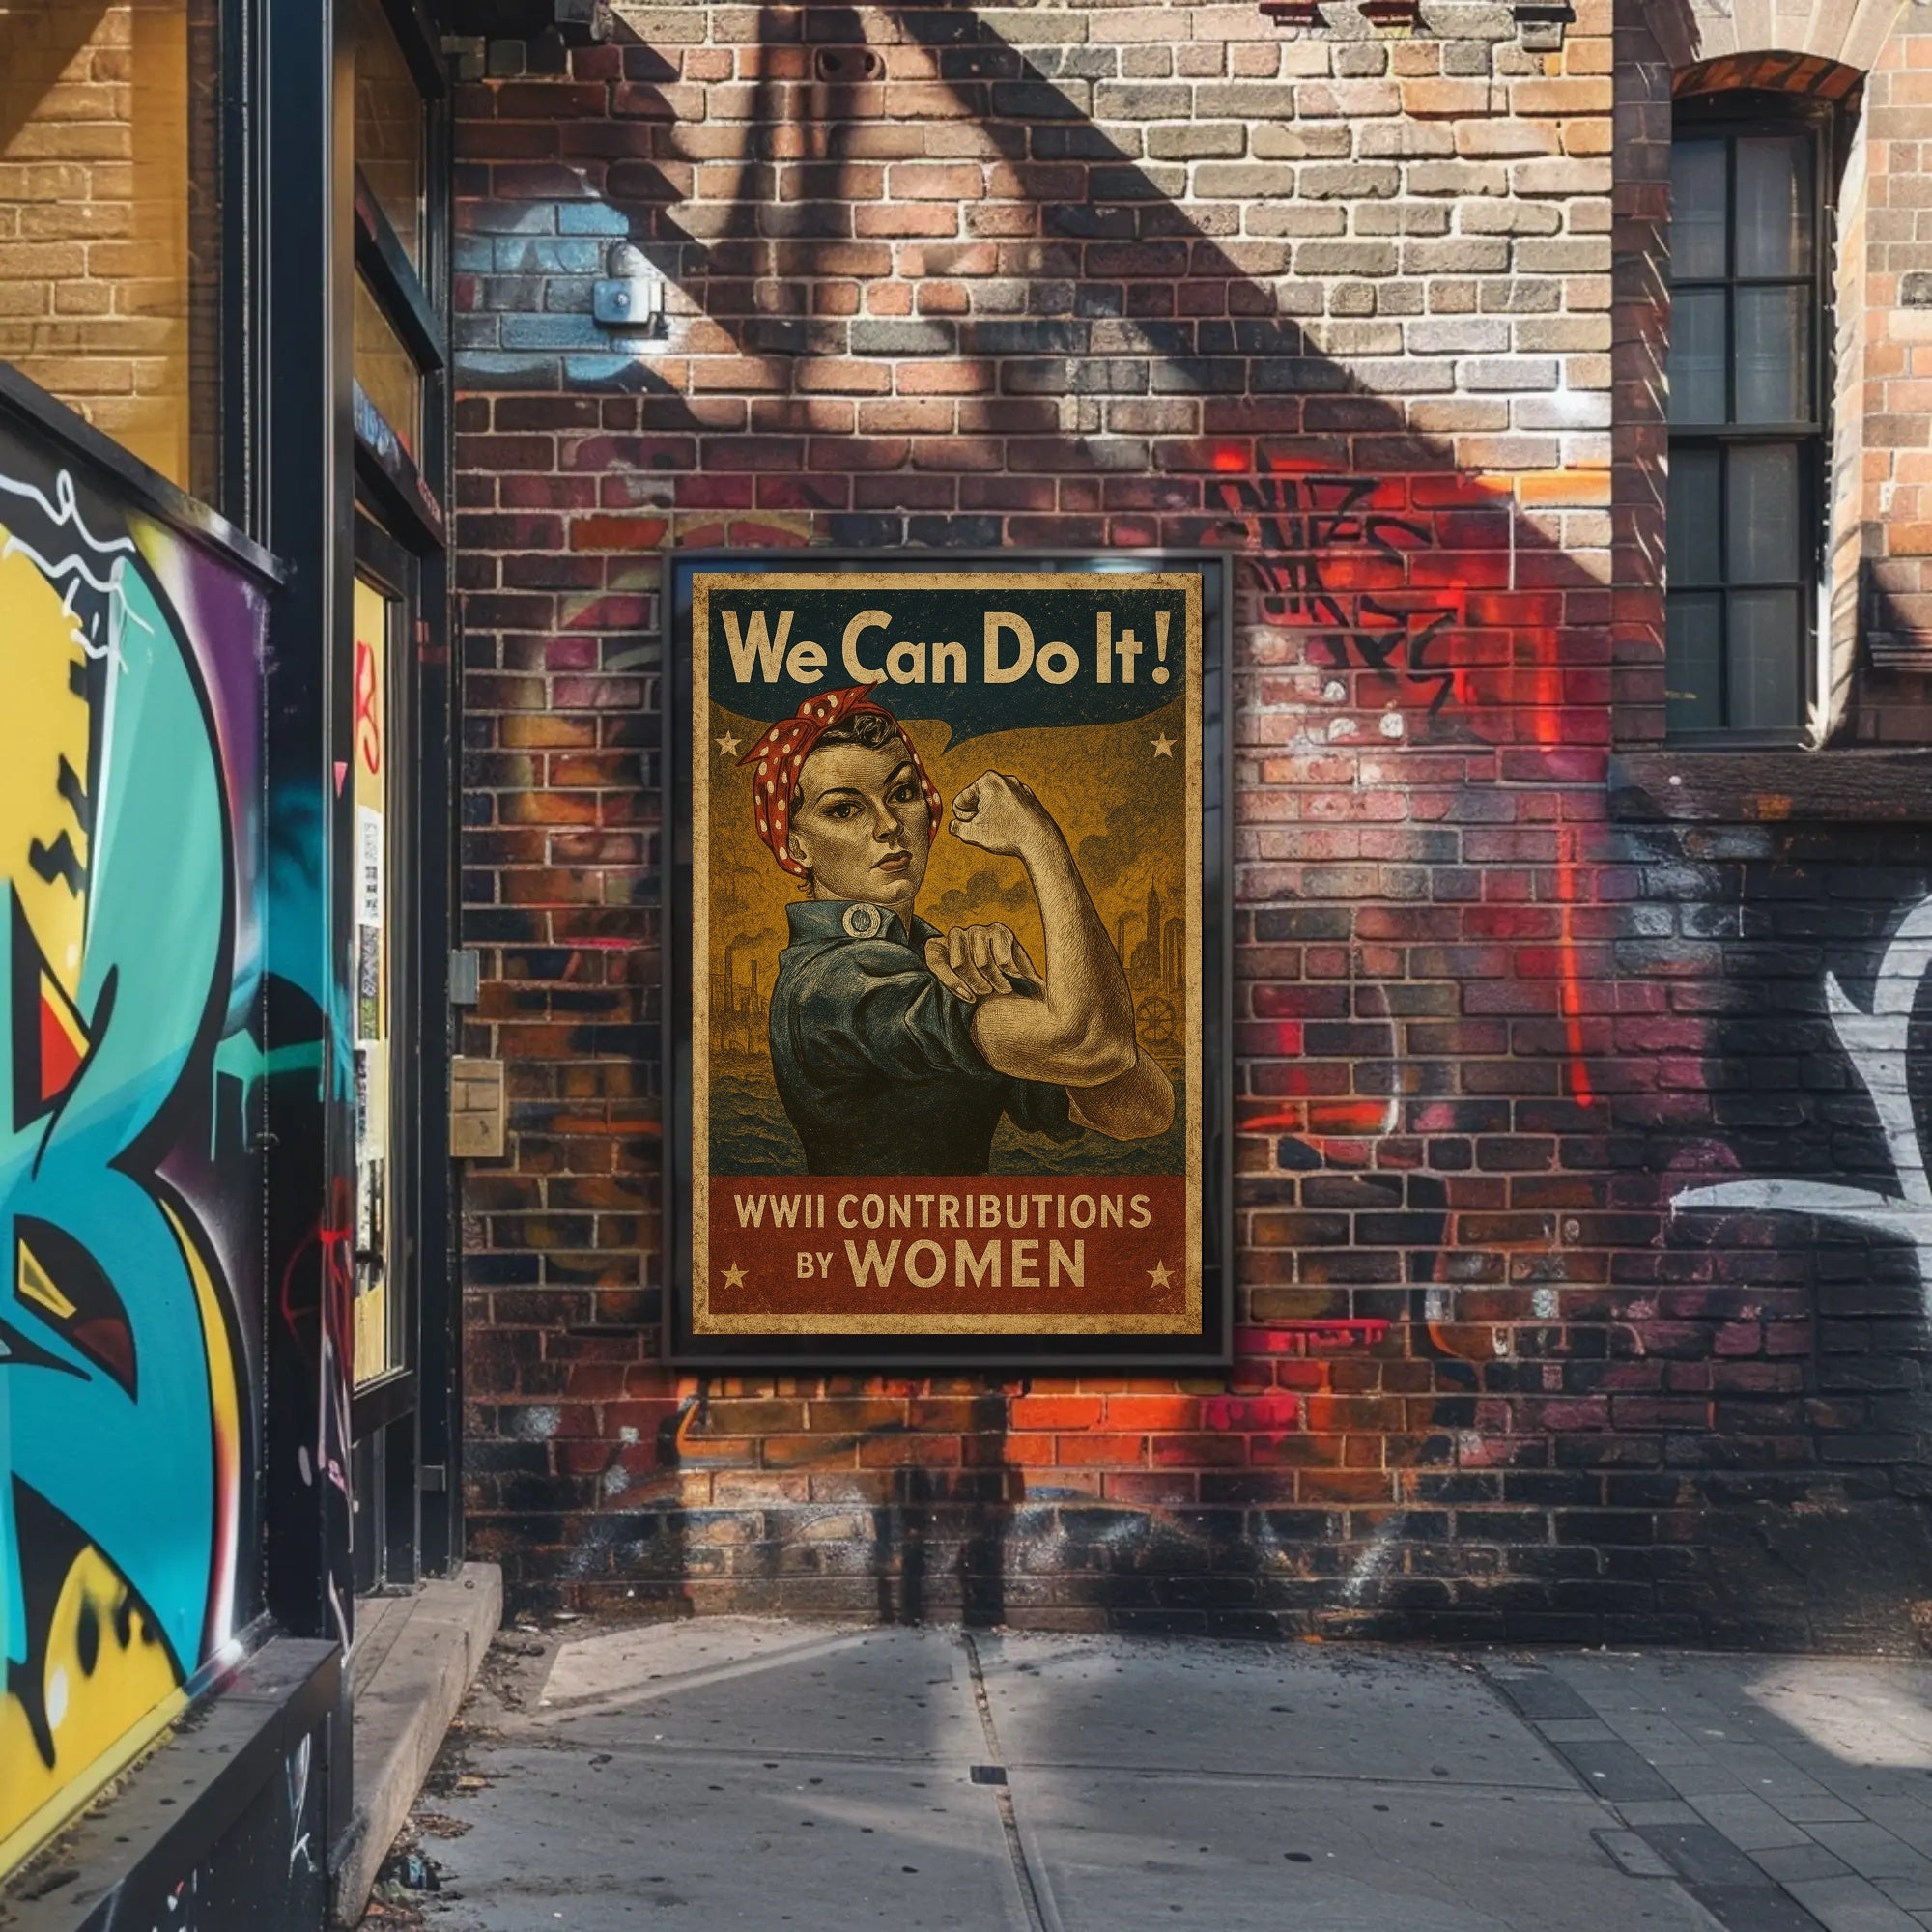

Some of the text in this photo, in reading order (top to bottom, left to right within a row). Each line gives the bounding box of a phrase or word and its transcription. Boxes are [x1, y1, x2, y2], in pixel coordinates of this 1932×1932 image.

[722, 610, 1172, 685] We Can Do It!
[734, 1193, 1152, 1229] WWII CONTRIBUTIONS
[797, 1239, 1086, 1288] BY WOMEN
